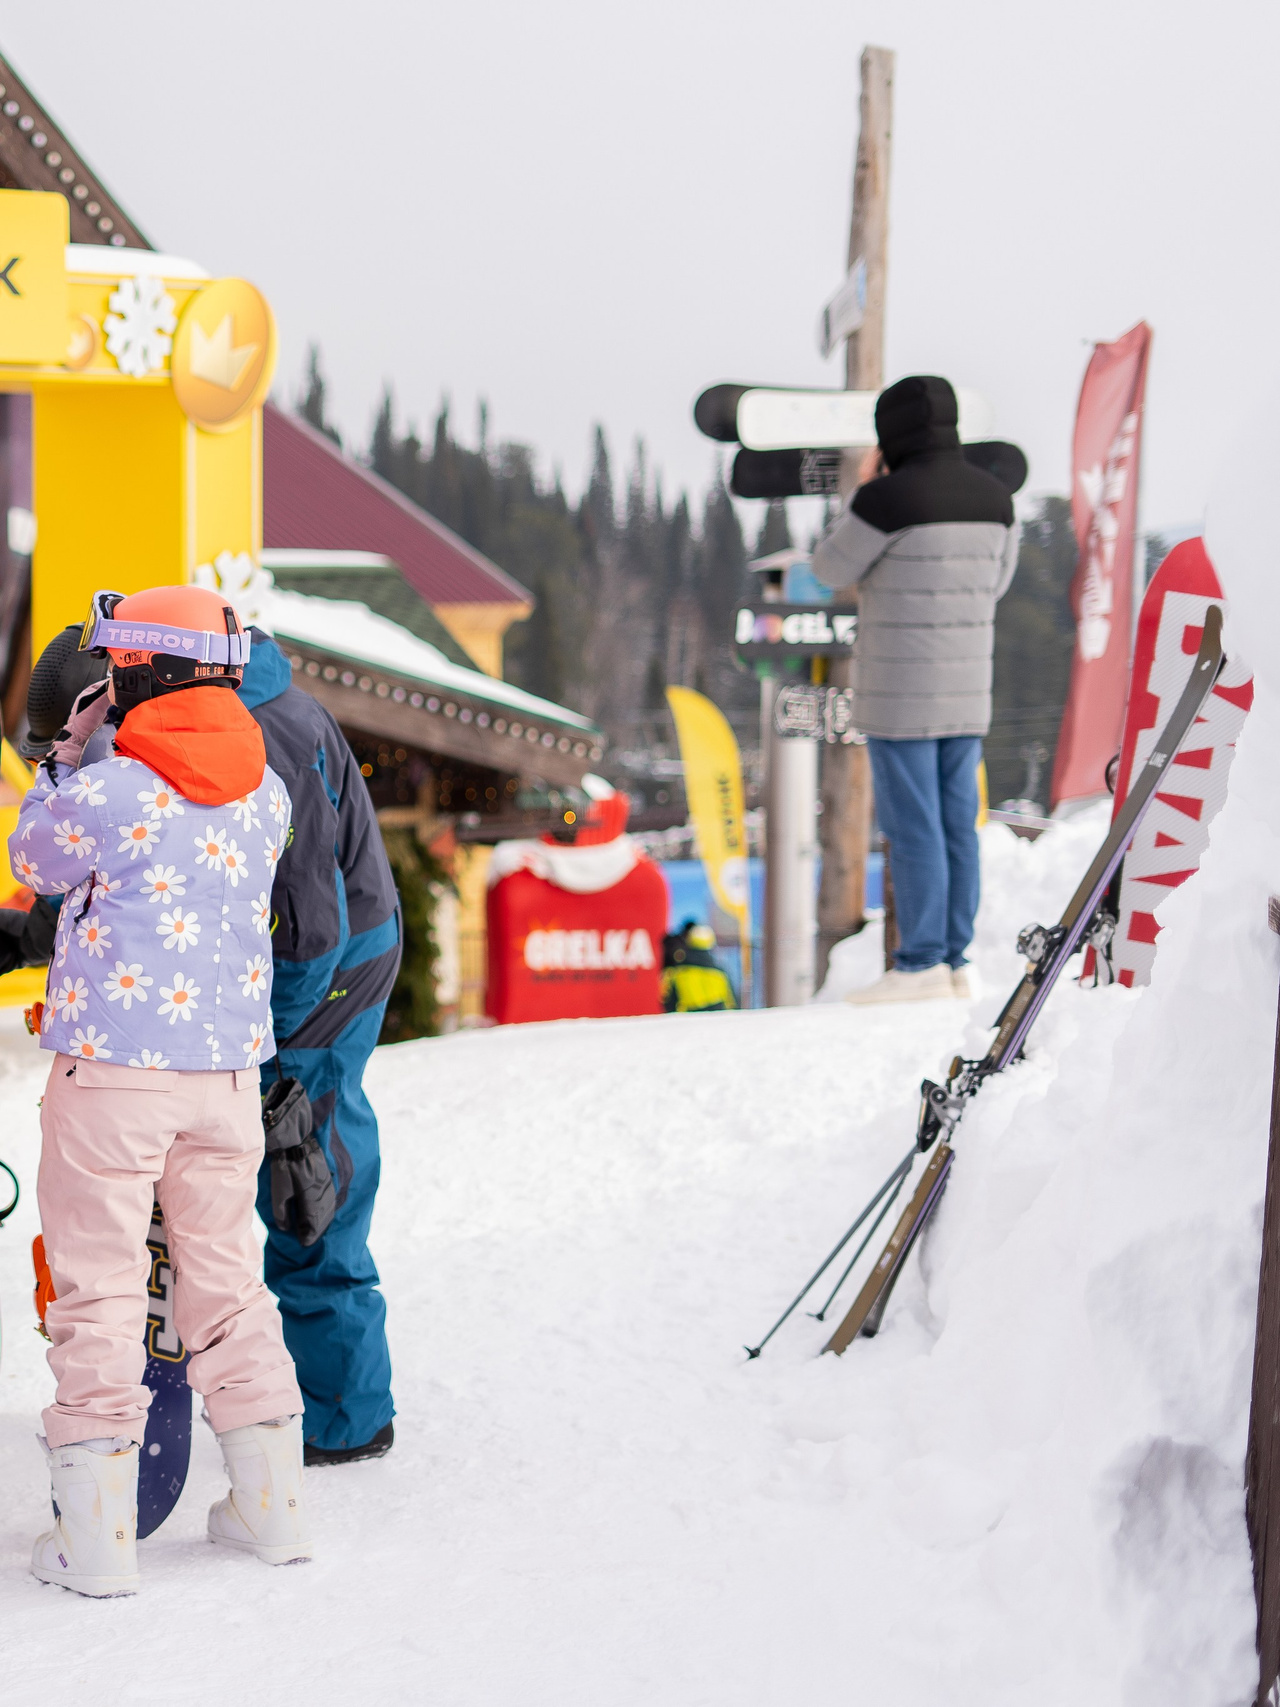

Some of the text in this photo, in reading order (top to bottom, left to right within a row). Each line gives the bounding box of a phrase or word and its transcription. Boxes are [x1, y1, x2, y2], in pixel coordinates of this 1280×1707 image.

[108, 628, 181, 648] TERRO
[194, 666, 211, 677] RIDE
[213, 666, 225, 675] FOR
